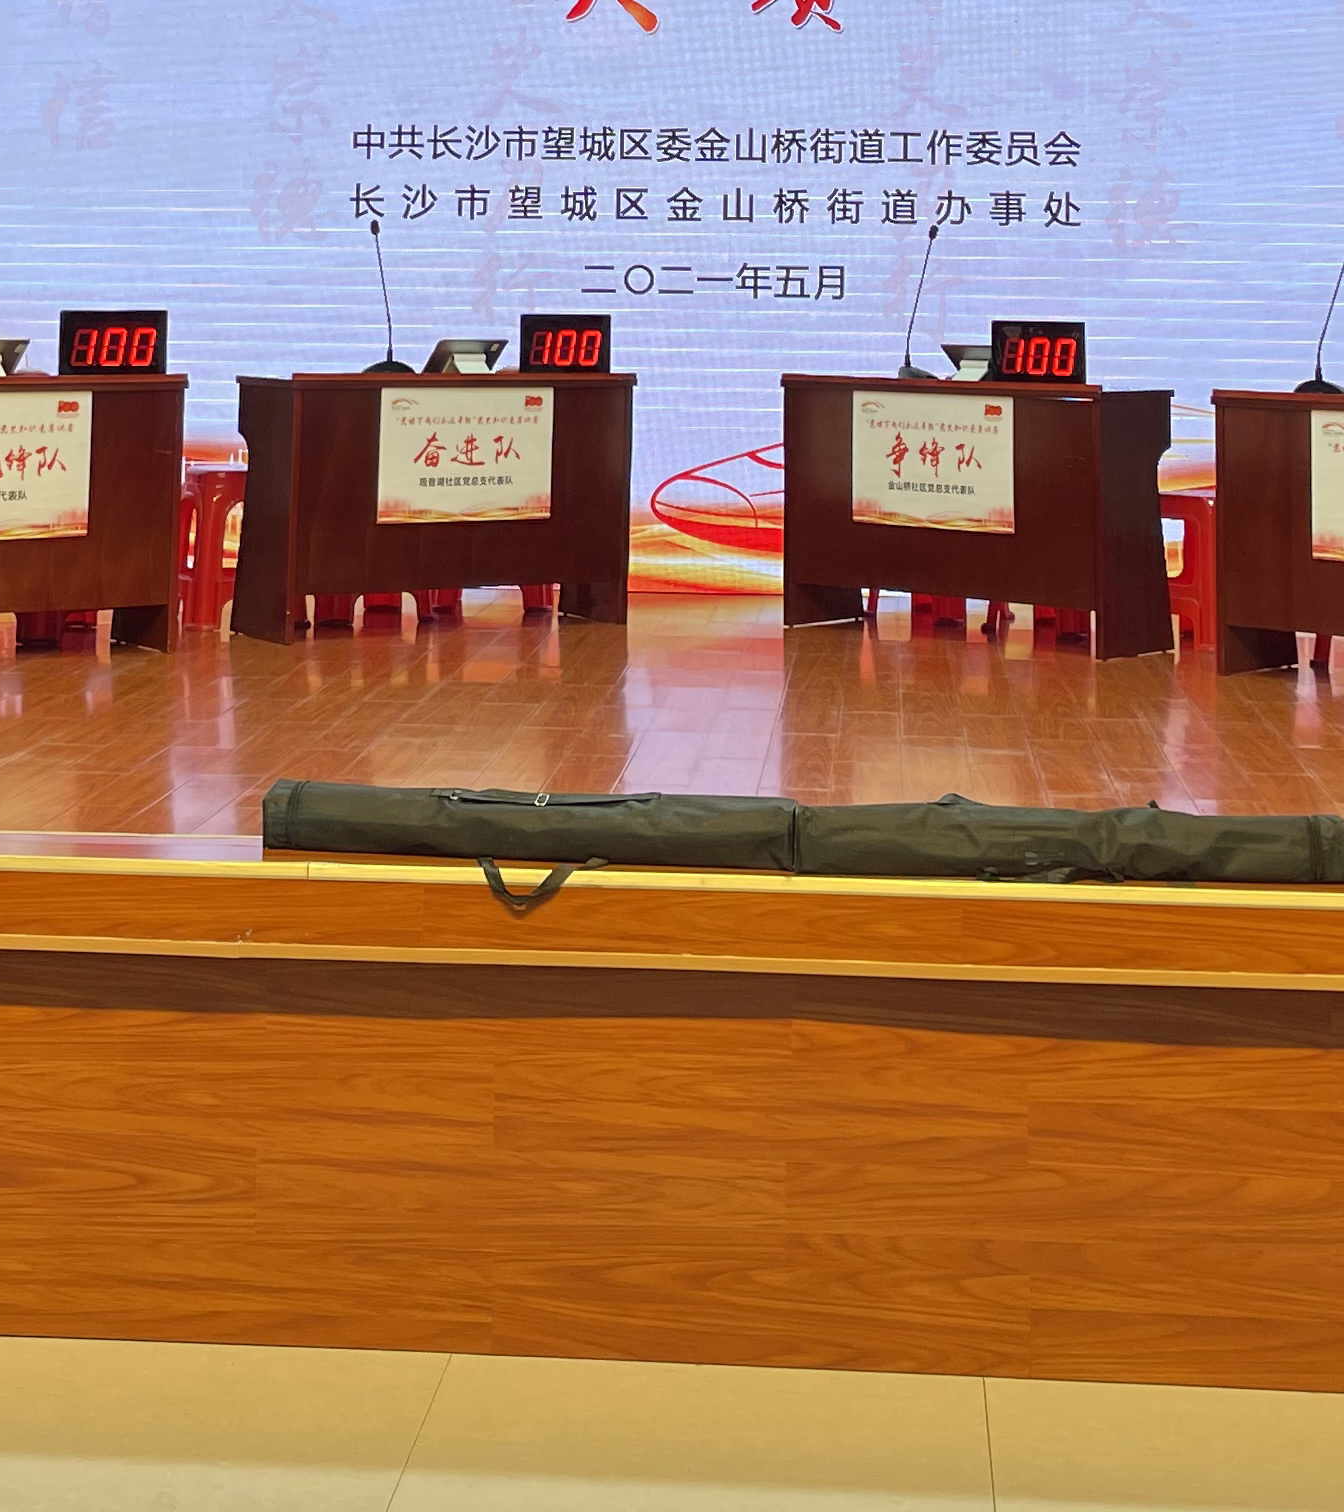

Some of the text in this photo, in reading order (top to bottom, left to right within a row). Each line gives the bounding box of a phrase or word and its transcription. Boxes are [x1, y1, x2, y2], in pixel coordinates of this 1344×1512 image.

[352, 123, 1083, 169] 中共长沙市望城区委金山桥街道工作委员会
[349, 183, 1083, 228] 长沙市望城区金山桥街道办事处
[69, 327, 158, 367] 100
[529, 329, 602, 367] 100
[1002, 337, 1077, 377] 100
[413, 431, 522, 468] 奋进队
[884, 431, 983, 478] 争锋队
